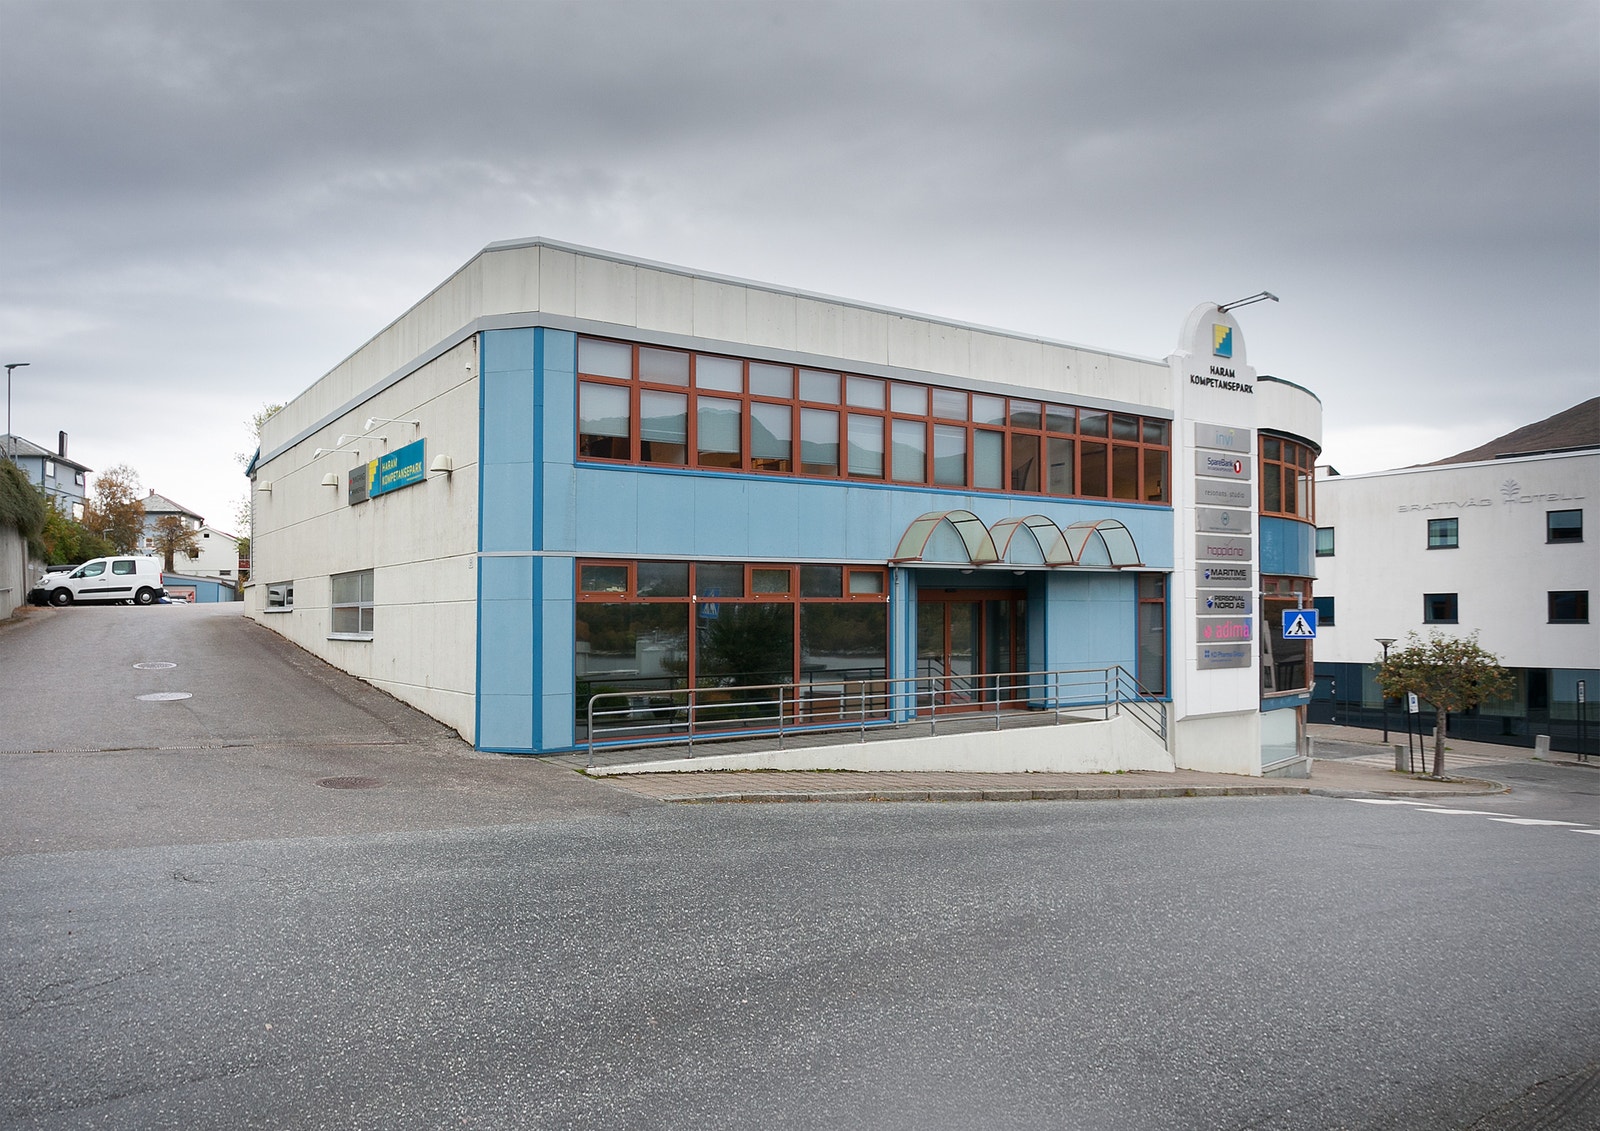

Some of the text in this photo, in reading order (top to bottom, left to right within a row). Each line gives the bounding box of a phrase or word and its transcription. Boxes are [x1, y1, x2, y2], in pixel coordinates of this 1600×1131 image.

[1210, 365, 1235, 378] HARAM
[1190, 374, 1254, 394] KOMPETANSEPARK
[382, 457, 397, 472] HARAM
[1207, 456, 1234, 468] SpareBank
[382, 462, 422, 485] KOMPETANSEPARK
[1210, 568, 1247, 577] MARITIME
[1215, 620, 1250, 638] adima
